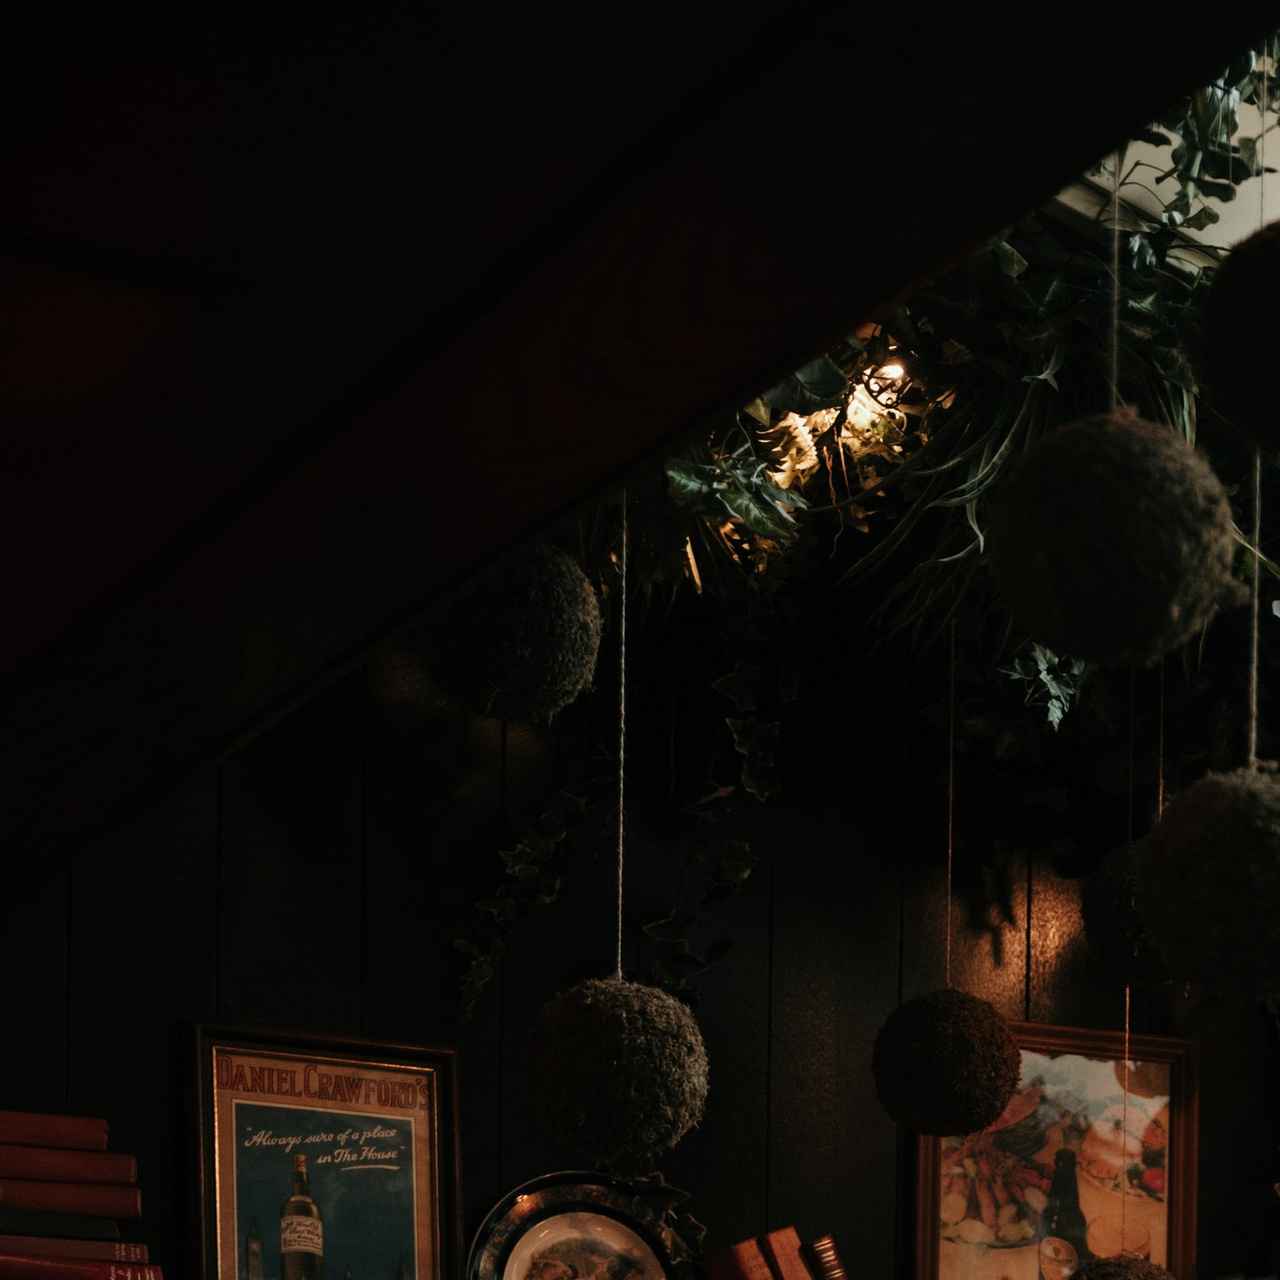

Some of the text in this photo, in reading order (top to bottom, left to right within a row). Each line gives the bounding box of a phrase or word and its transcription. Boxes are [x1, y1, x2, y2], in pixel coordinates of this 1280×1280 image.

[217, 1055, 431, 1110] DANIEL CRAWFORD'S
[304, 1132, 334, 1144] sure
[336, 1128, 352, 1146] of
[351, 1132, 359, 1140] a
[359, 1125, 397, 1145] place
[316, 1154, 332, 1164] in
[333, 1148, 358, 1164] The
